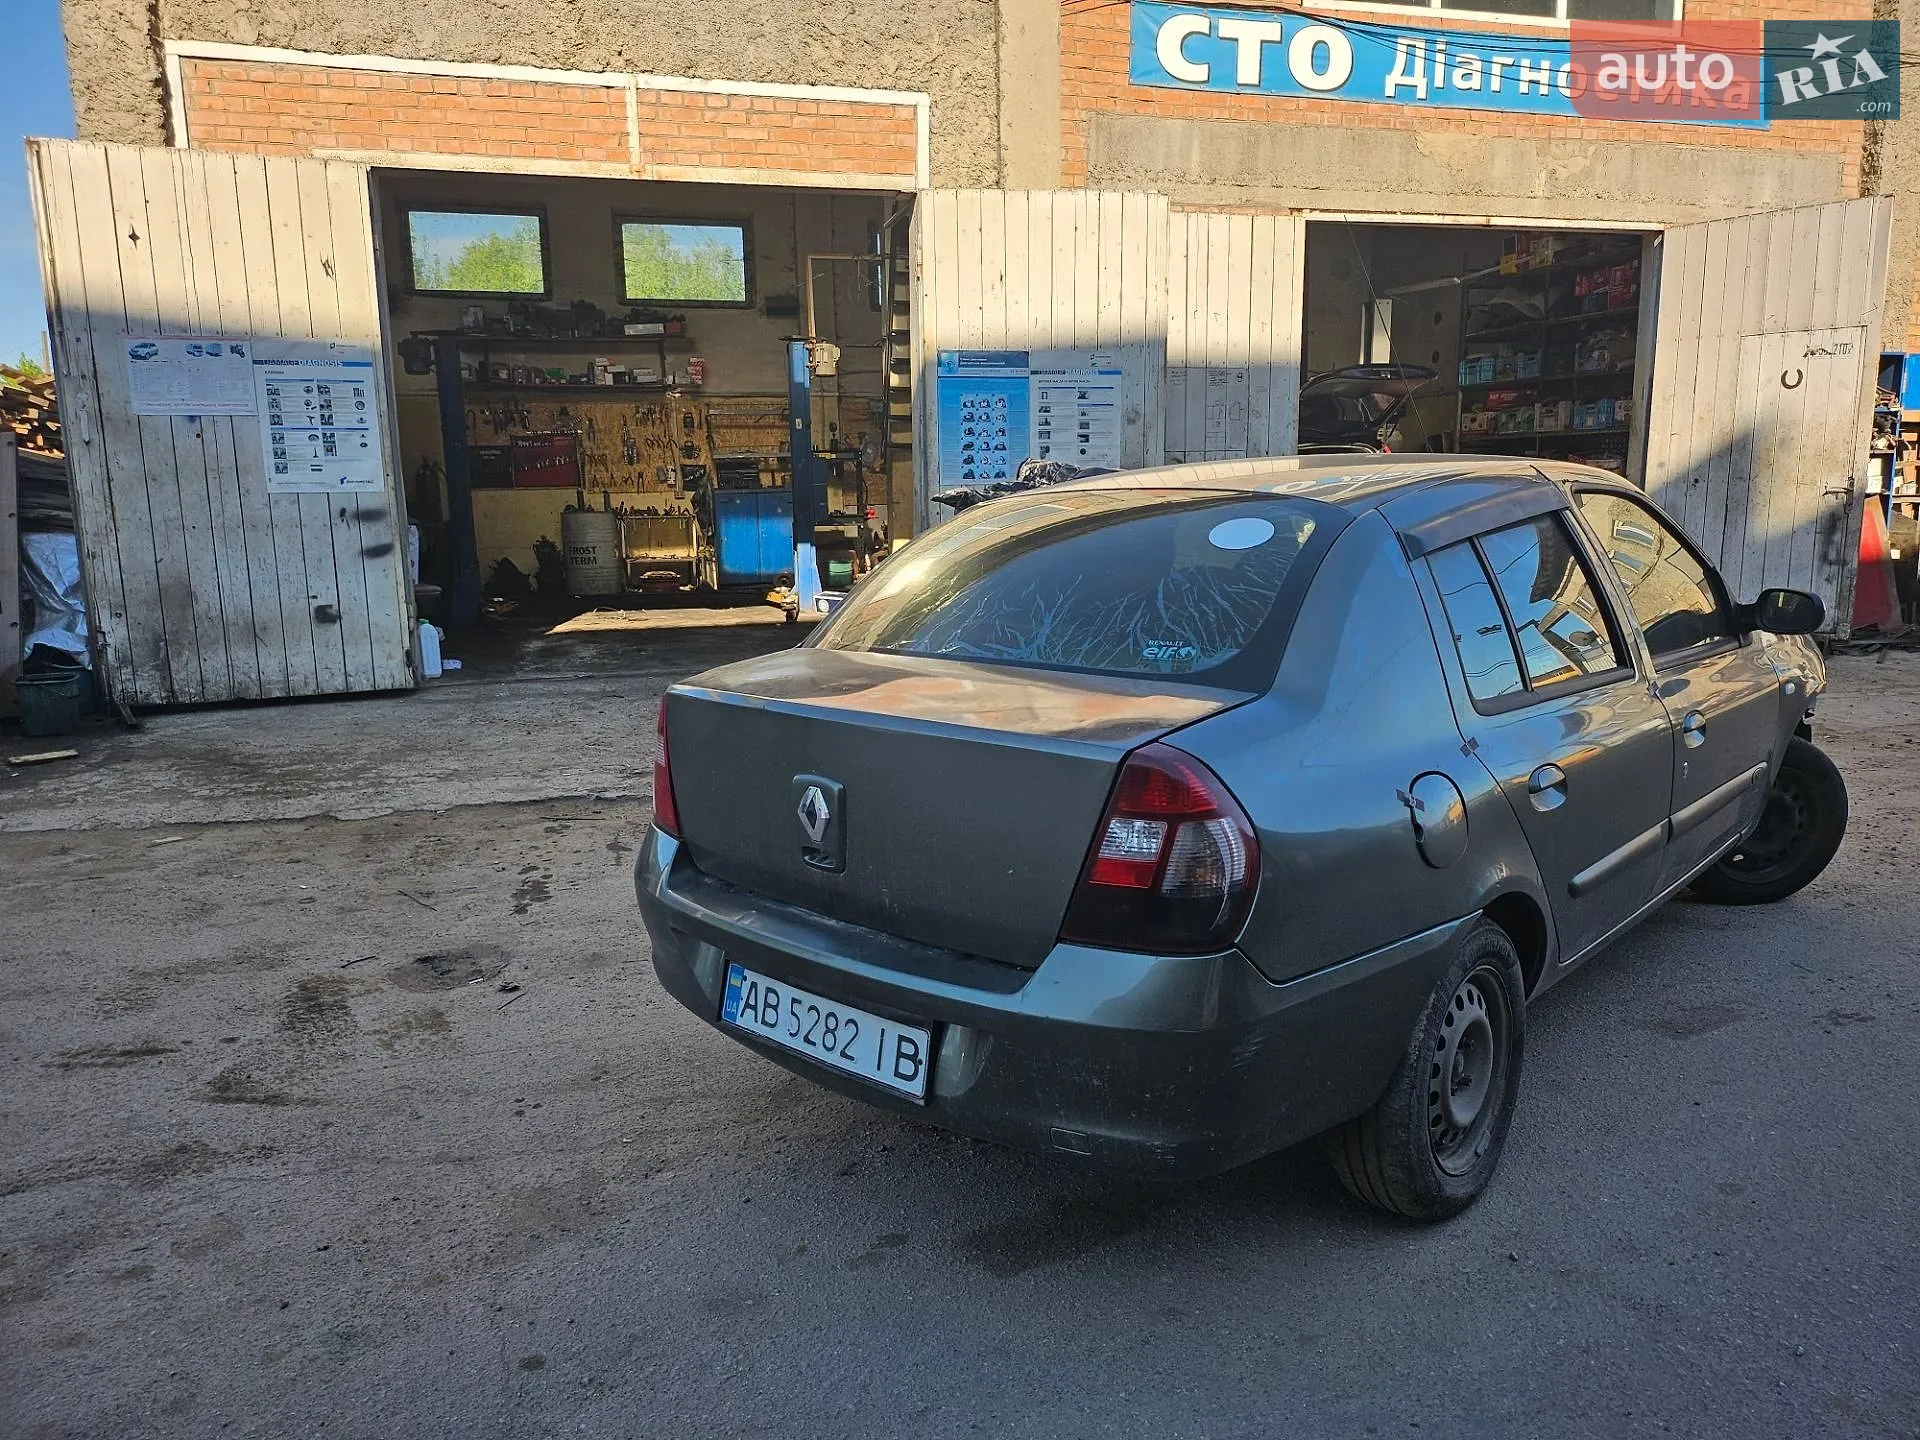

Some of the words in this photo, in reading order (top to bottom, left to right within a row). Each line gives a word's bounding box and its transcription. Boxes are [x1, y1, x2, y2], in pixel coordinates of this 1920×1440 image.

[1156, 13, 1354, 92] СТО
[569, 546, 598, 555] FROST
[571, 556, 598, 566] TERM
[726, 1000, 738, 1013] UA
[740, 981, 780, 1029] AB
[787, 997, 859, 1062] 5282
[876, 1028, 920, 1082] IB
